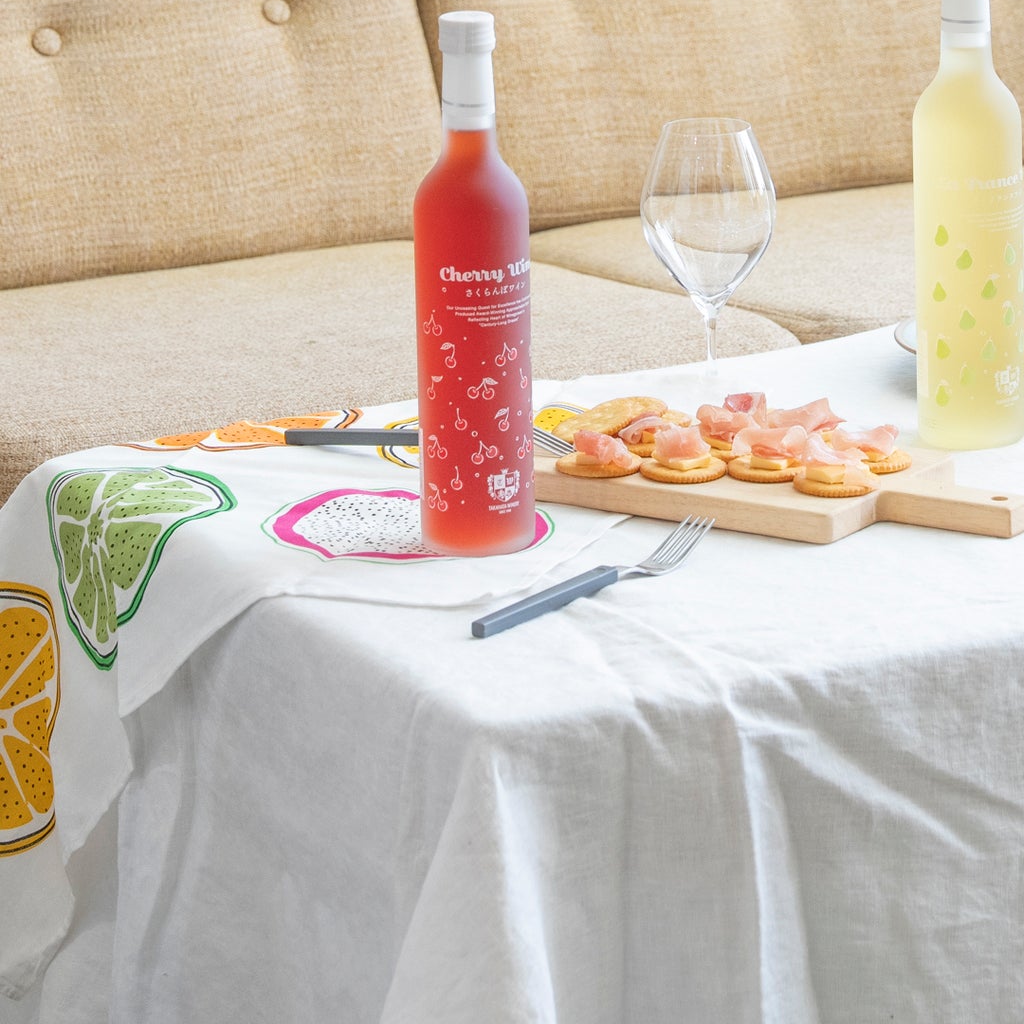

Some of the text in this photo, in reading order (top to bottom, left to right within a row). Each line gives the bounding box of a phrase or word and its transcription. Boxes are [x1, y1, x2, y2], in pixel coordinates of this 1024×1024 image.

[440, 266, 505, 283] Cherry
[465, 281, 526, 298] さくらんぼワイン
